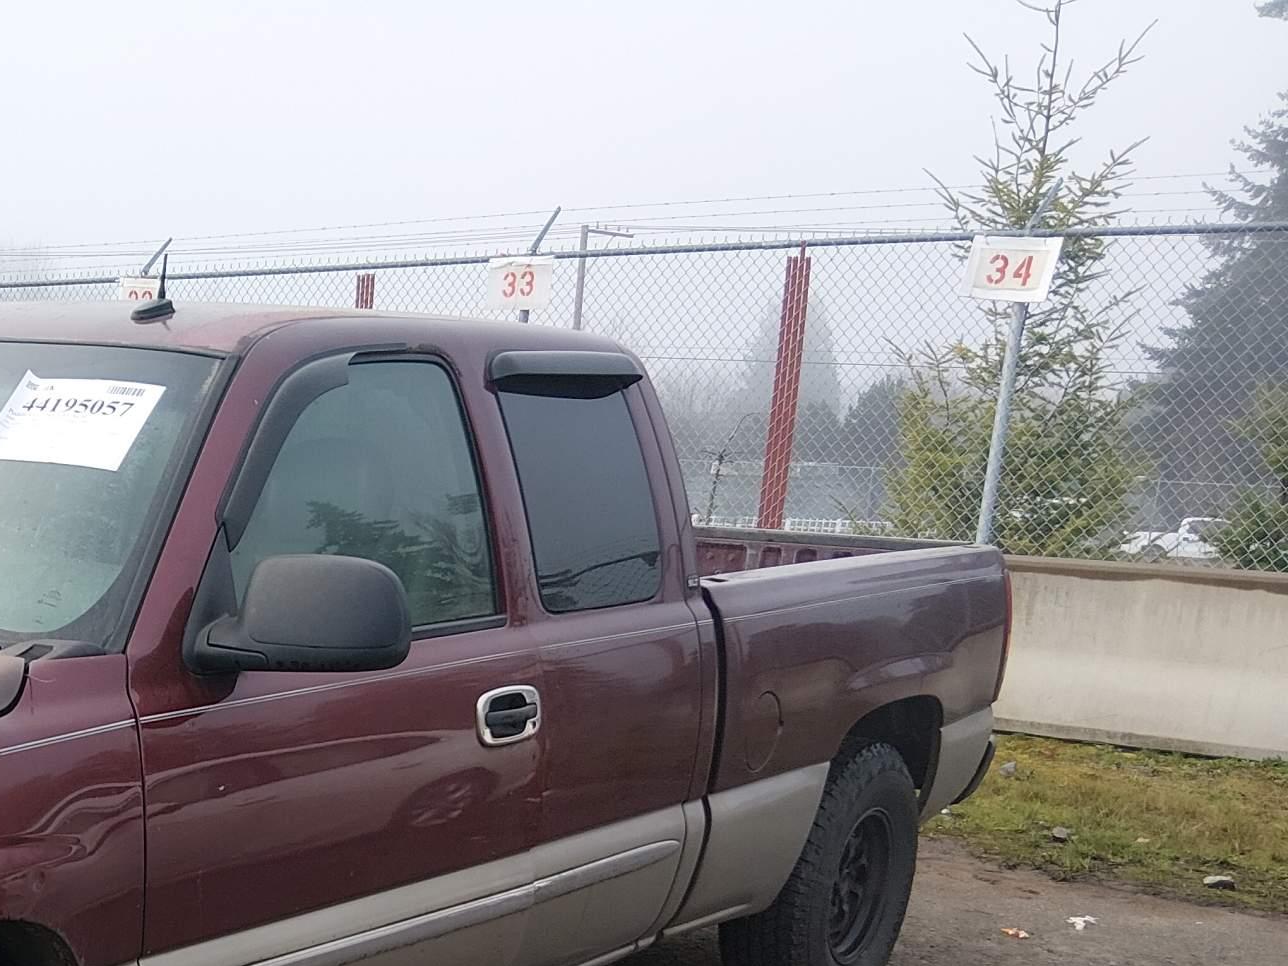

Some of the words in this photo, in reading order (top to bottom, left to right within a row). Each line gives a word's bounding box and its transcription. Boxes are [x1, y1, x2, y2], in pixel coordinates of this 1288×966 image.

[502, 270, 535, 298] 33
[985, 254, 1034, 287] 34
[22, 397, 136, 417] 44195057
